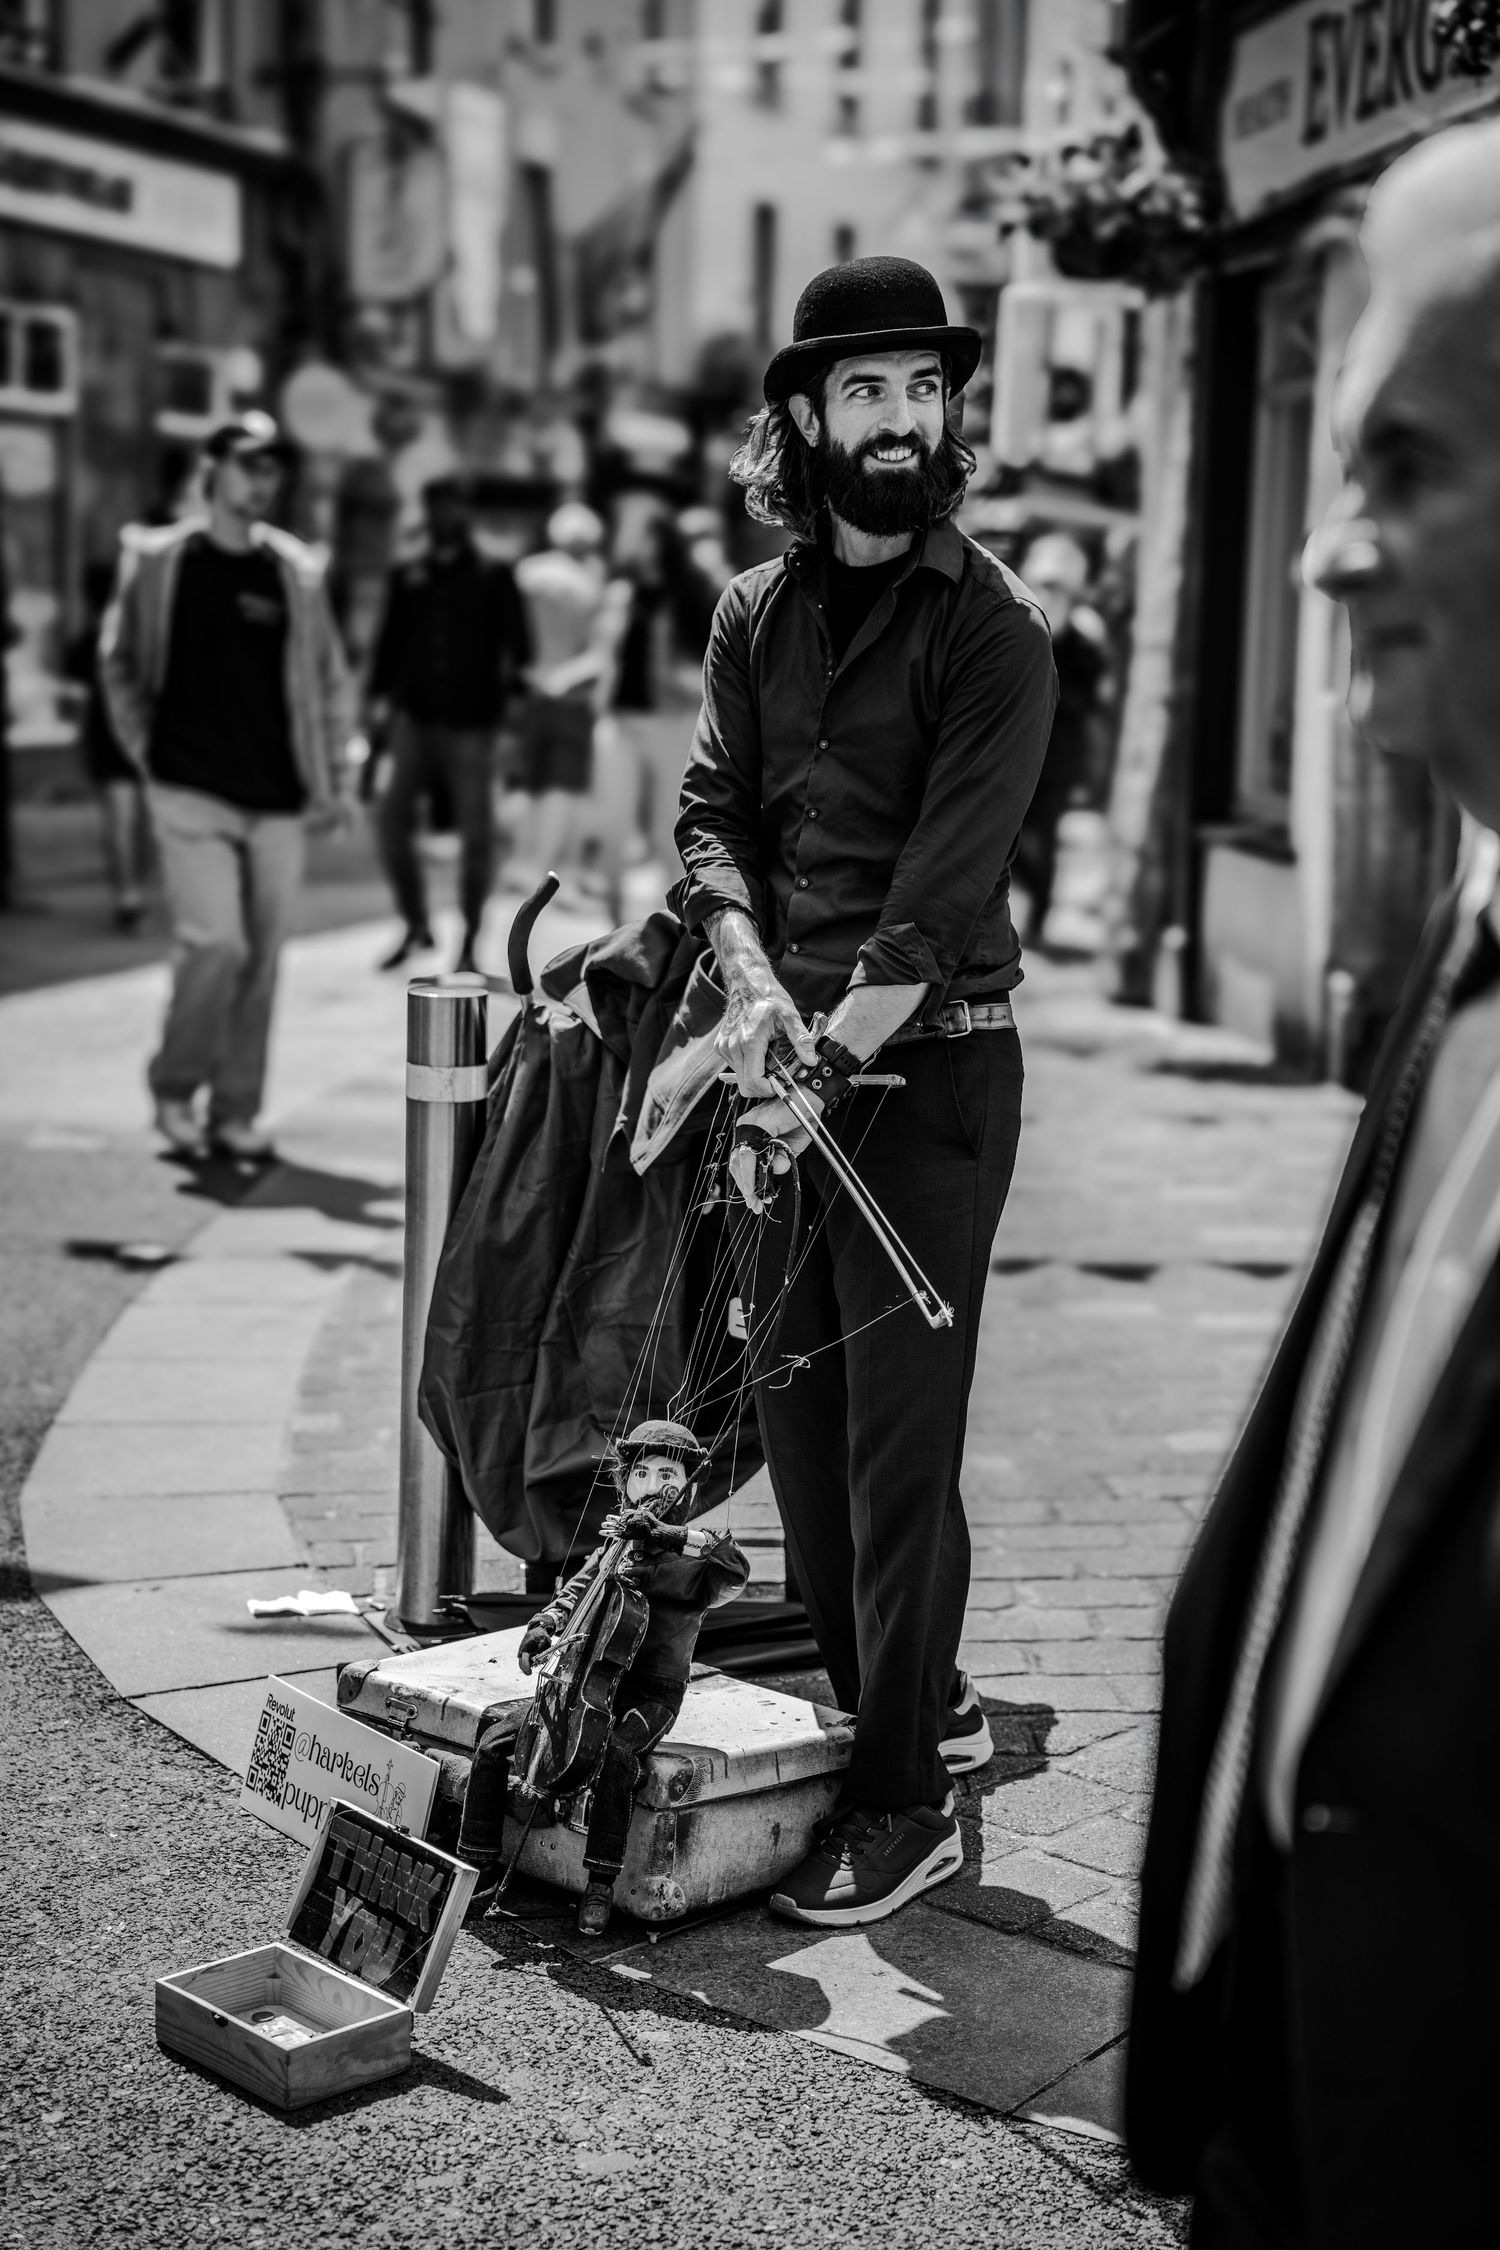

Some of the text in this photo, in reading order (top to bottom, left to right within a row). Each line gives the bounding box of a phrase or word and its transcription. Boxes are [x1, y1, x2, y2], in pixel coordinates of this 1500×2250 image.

[266, 1693, 296, 1722] Revolut
[294, 1732, 381, 1796] @harkels
[328, 1815, 445, 1933] THANK
[318, 1886, 407, 1985] YOU
